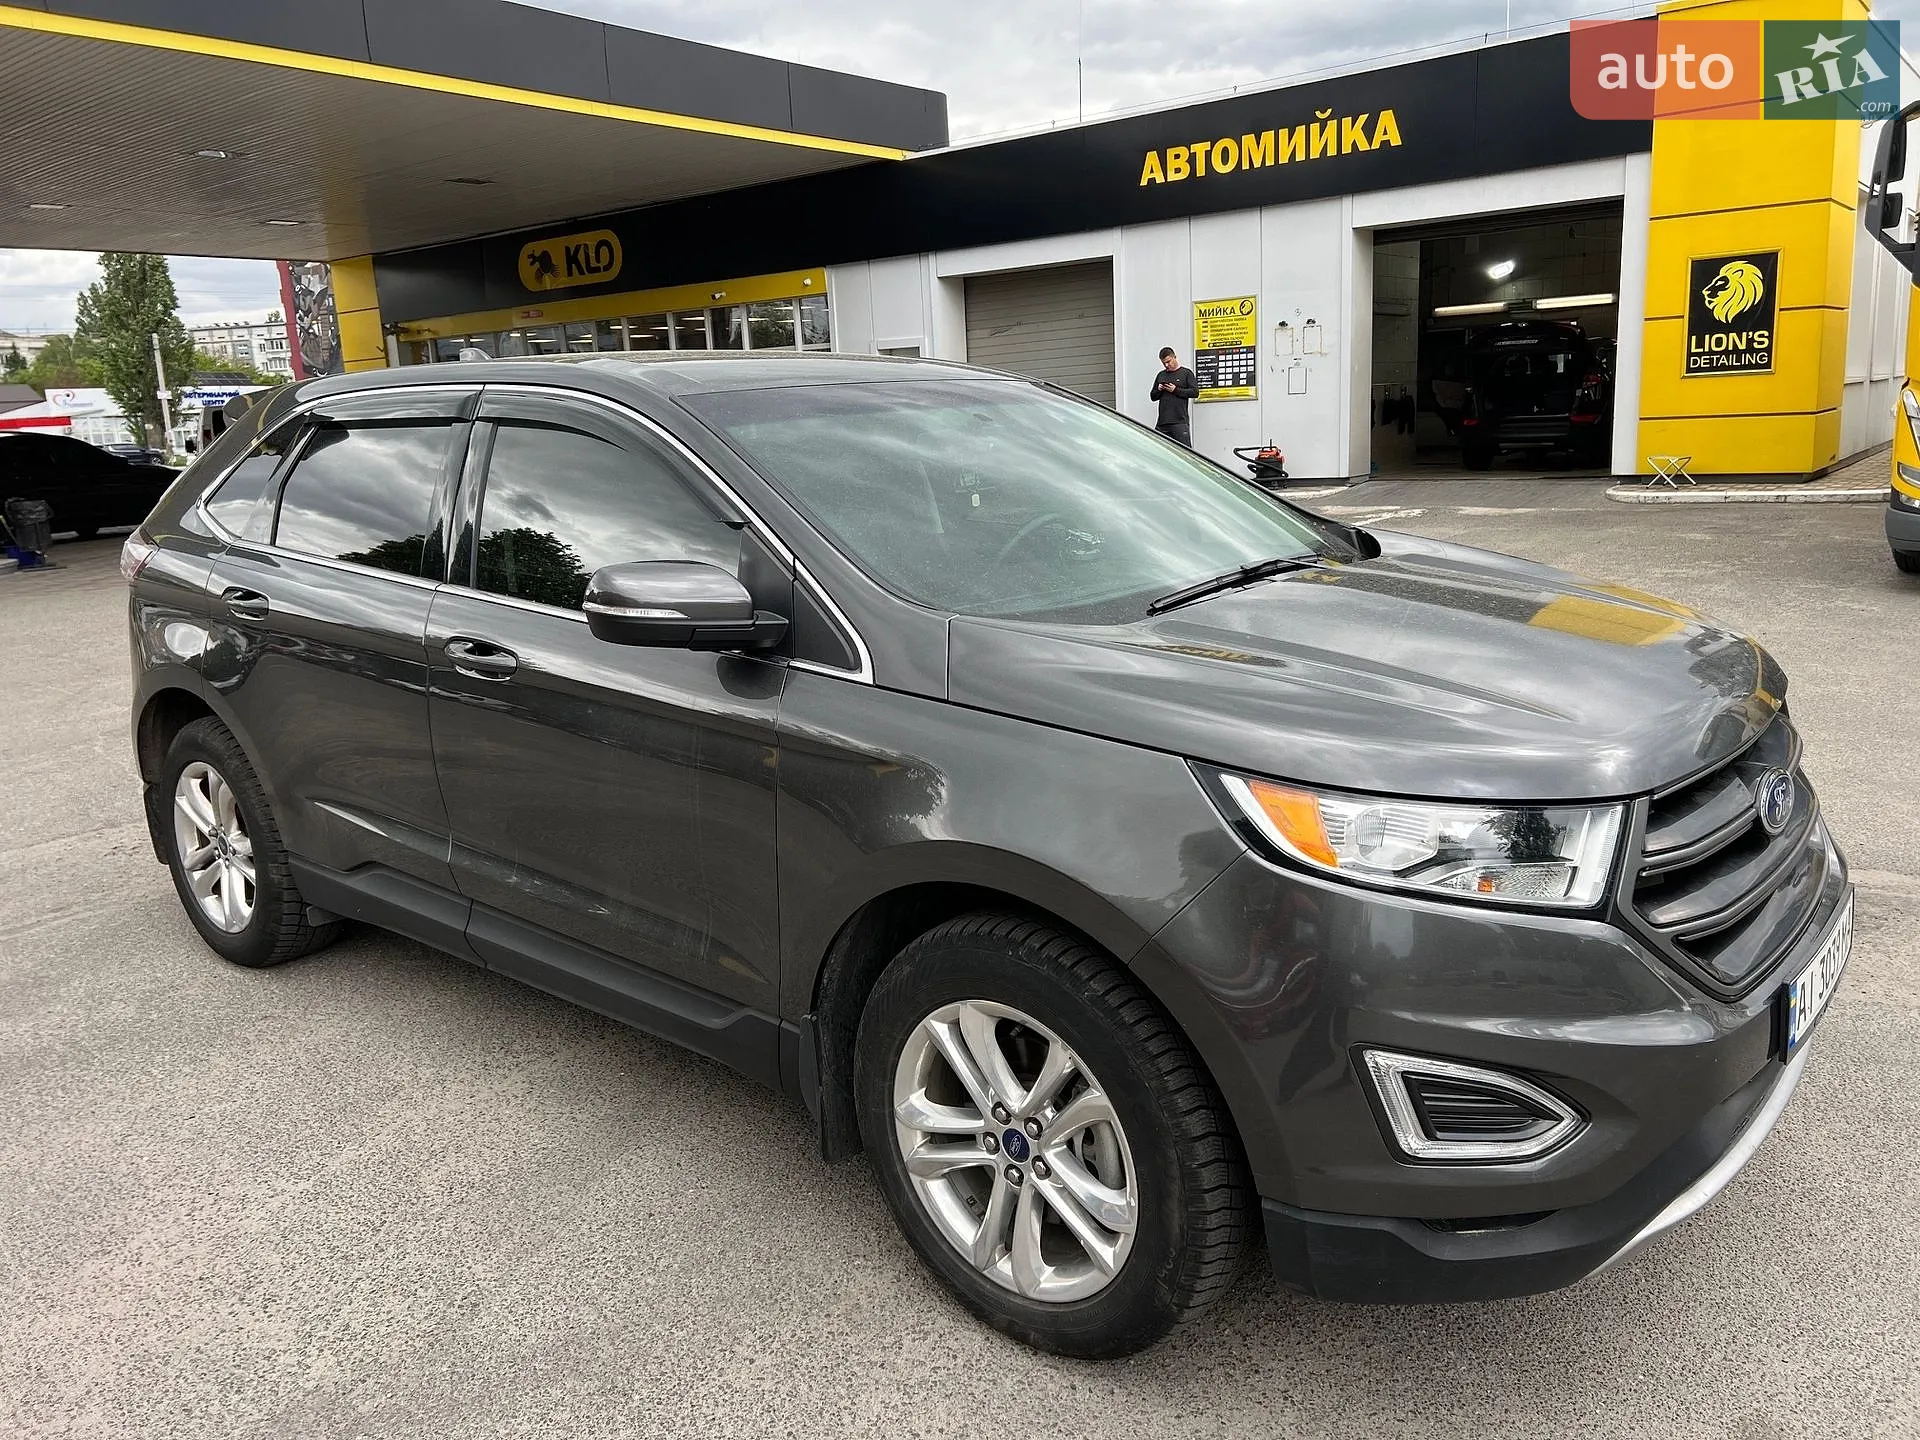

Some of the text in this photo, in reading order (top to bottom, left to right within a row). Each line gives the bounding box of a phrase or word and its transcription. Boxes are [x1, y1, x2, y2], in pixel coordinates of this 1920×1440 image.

[1140, 108, 1402, 186] АВТОМИЙКА
[564, 238, 615, 277] KLO
[1198, 305, 1236, 317] МИЙКА
[1690, 330, 1769, 353] LION'S
[1690, 352, 1769, 368] DETAILING
